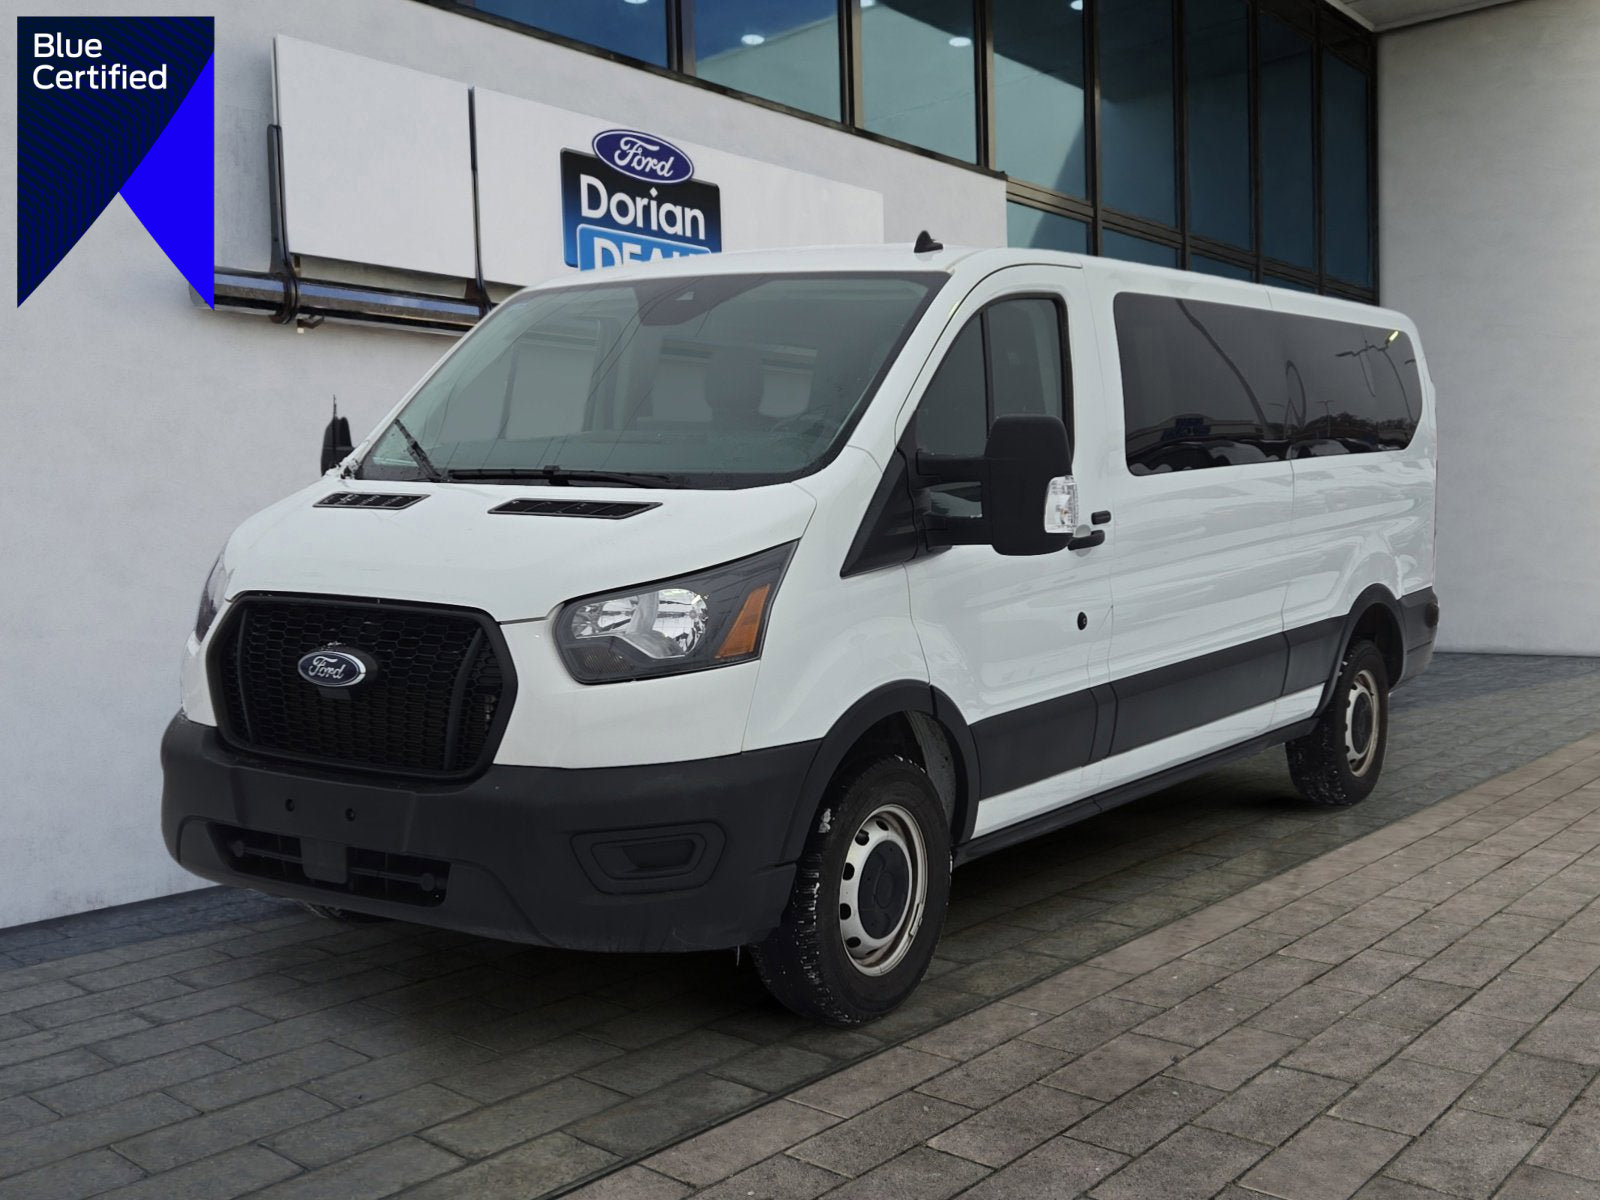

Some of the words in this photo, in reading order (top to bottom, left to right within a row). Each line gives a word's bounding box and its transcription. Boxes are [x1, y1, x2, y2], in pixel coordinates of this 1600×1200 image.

[613, 136, 675, 177] Ford
[580, 173, 706, 241] Dorian
[308, 656, 346, 679] Ford
